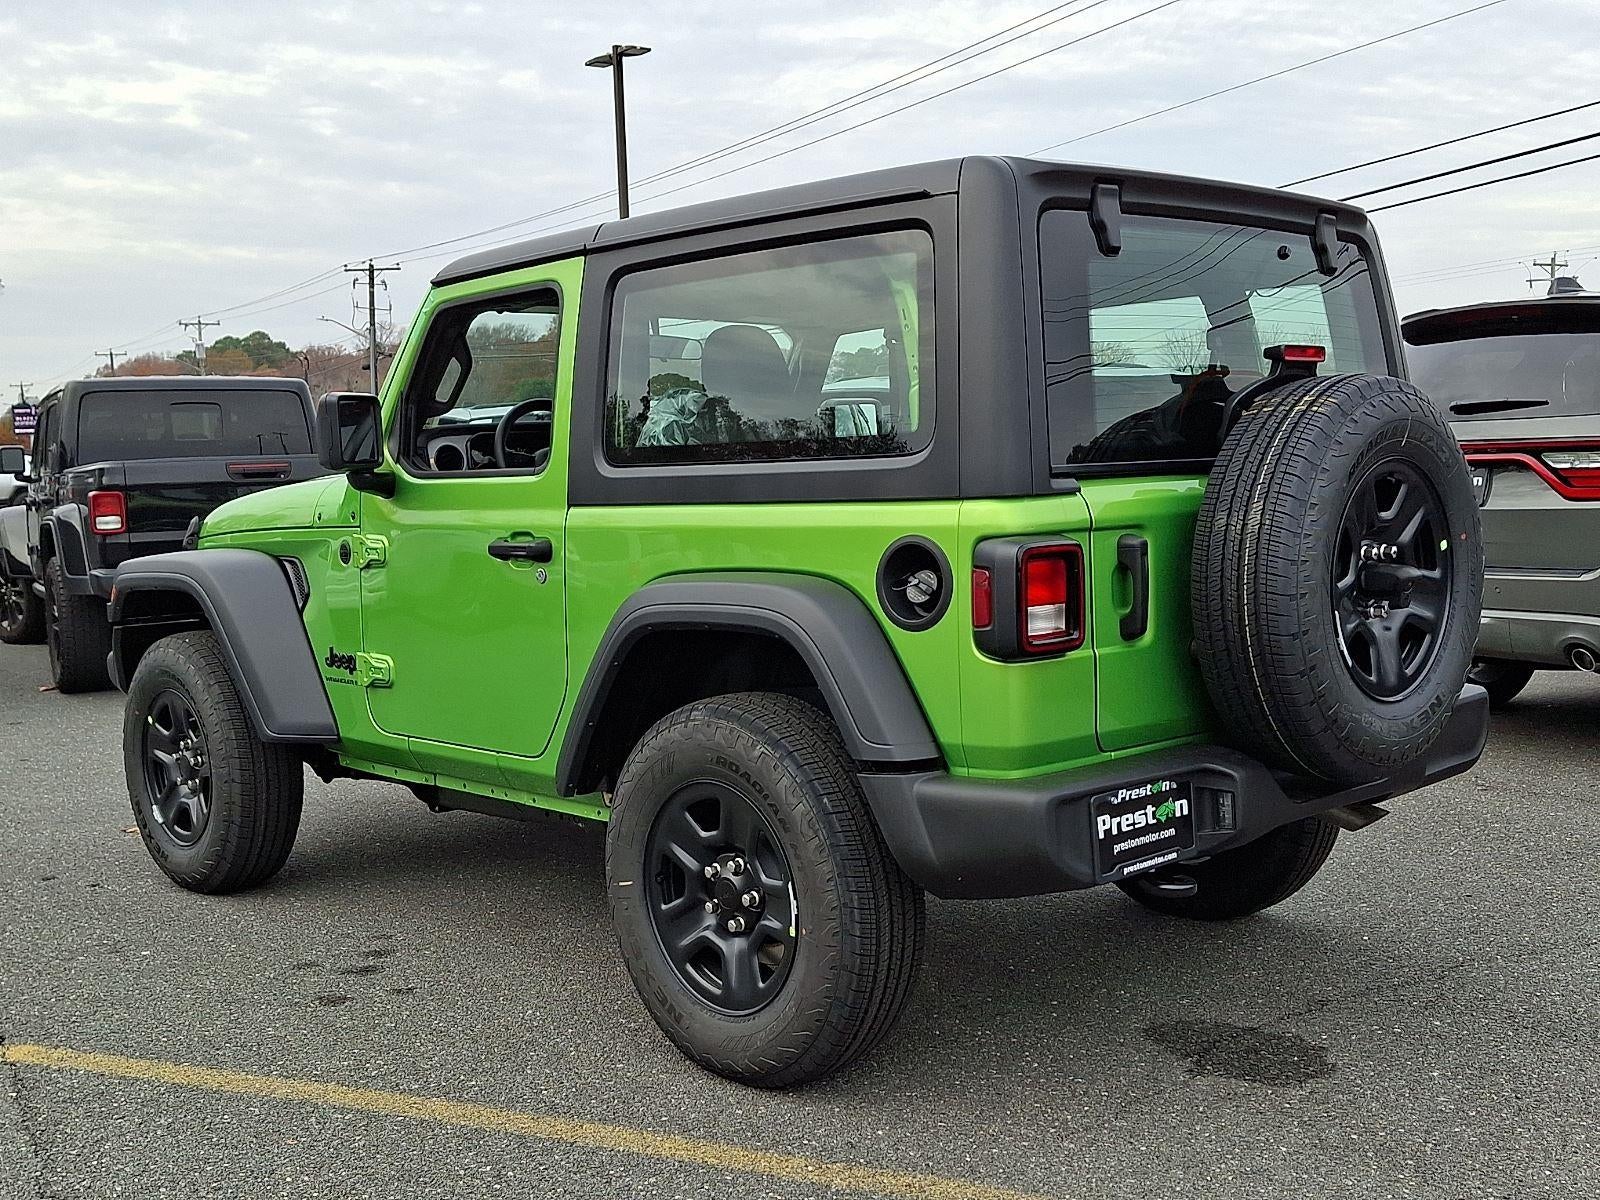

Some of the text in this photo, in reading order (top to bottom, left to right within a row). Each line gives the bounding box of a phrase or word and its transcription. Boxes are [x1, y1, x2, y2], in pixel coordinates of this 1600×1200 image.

[324, 646, 357, 675] Jeep
[1113, 827, 1176, 856] prestonmotor.com
[1124, 851, 1177, 875] prestonmotor.com
